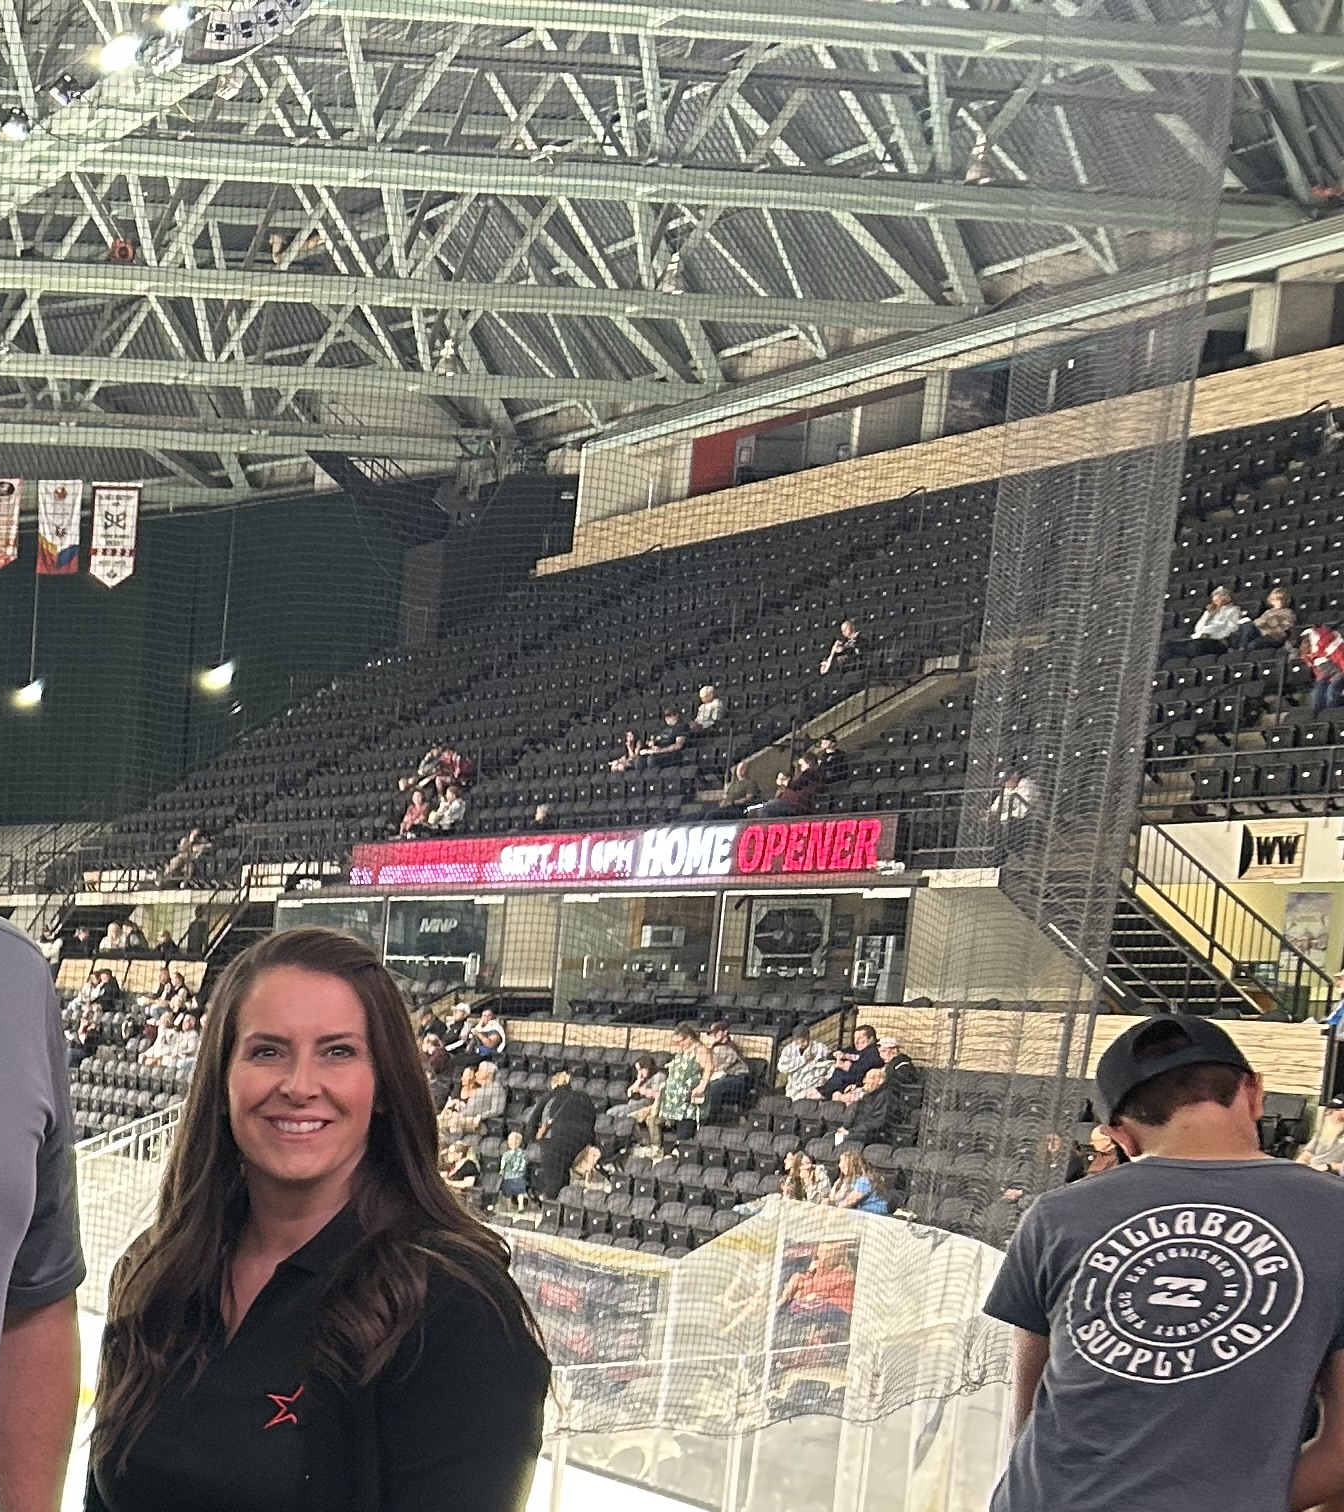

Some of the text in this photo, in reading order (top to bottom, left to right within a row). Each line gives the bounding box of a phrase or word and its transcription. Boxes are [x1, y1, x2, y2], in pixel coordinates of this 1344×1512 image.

[637, 826, 737, 877] HOME
[738, 819, 882, 874] OPENER
[419, 917, 458, 934] MNP
[1088, 1210, 1289, 1276] BILLABONG
[1125, 1247, 1237, 1284] ESTABLISHED
[1076, 1319, 1274, 1377] SUPPLY CO.
